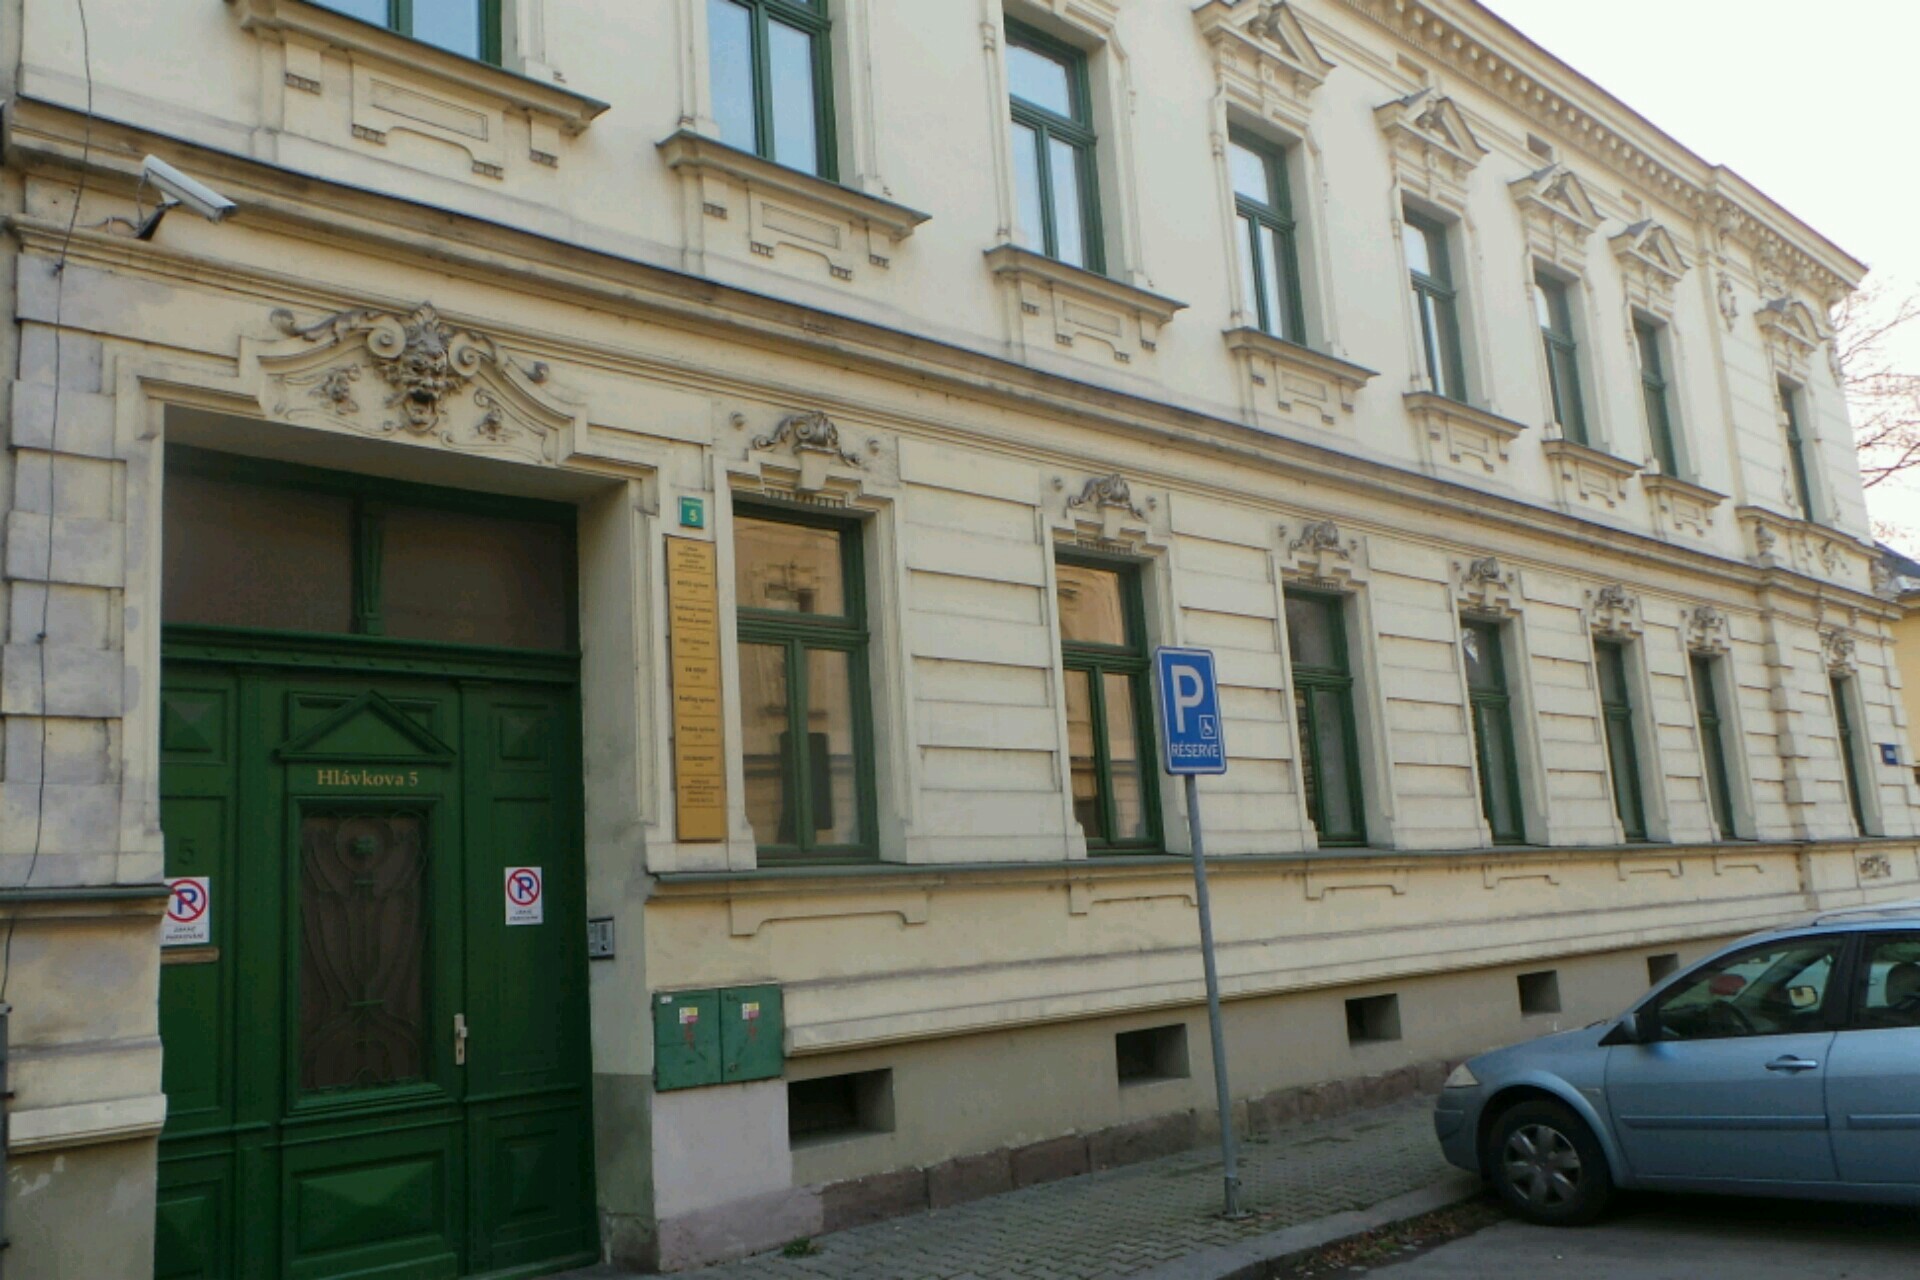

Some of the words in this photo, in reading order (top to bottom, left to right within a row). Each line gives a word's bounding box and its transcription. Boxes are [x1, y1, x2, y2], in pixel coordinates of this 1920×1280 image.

[688, 509, 698, 522] 5
[1171, 665, 1204, 734] P
[317, 769, 404, 786] Hlávkova
[408, 771, 418, 786] 5
[177, 837, 196, 865] 5
